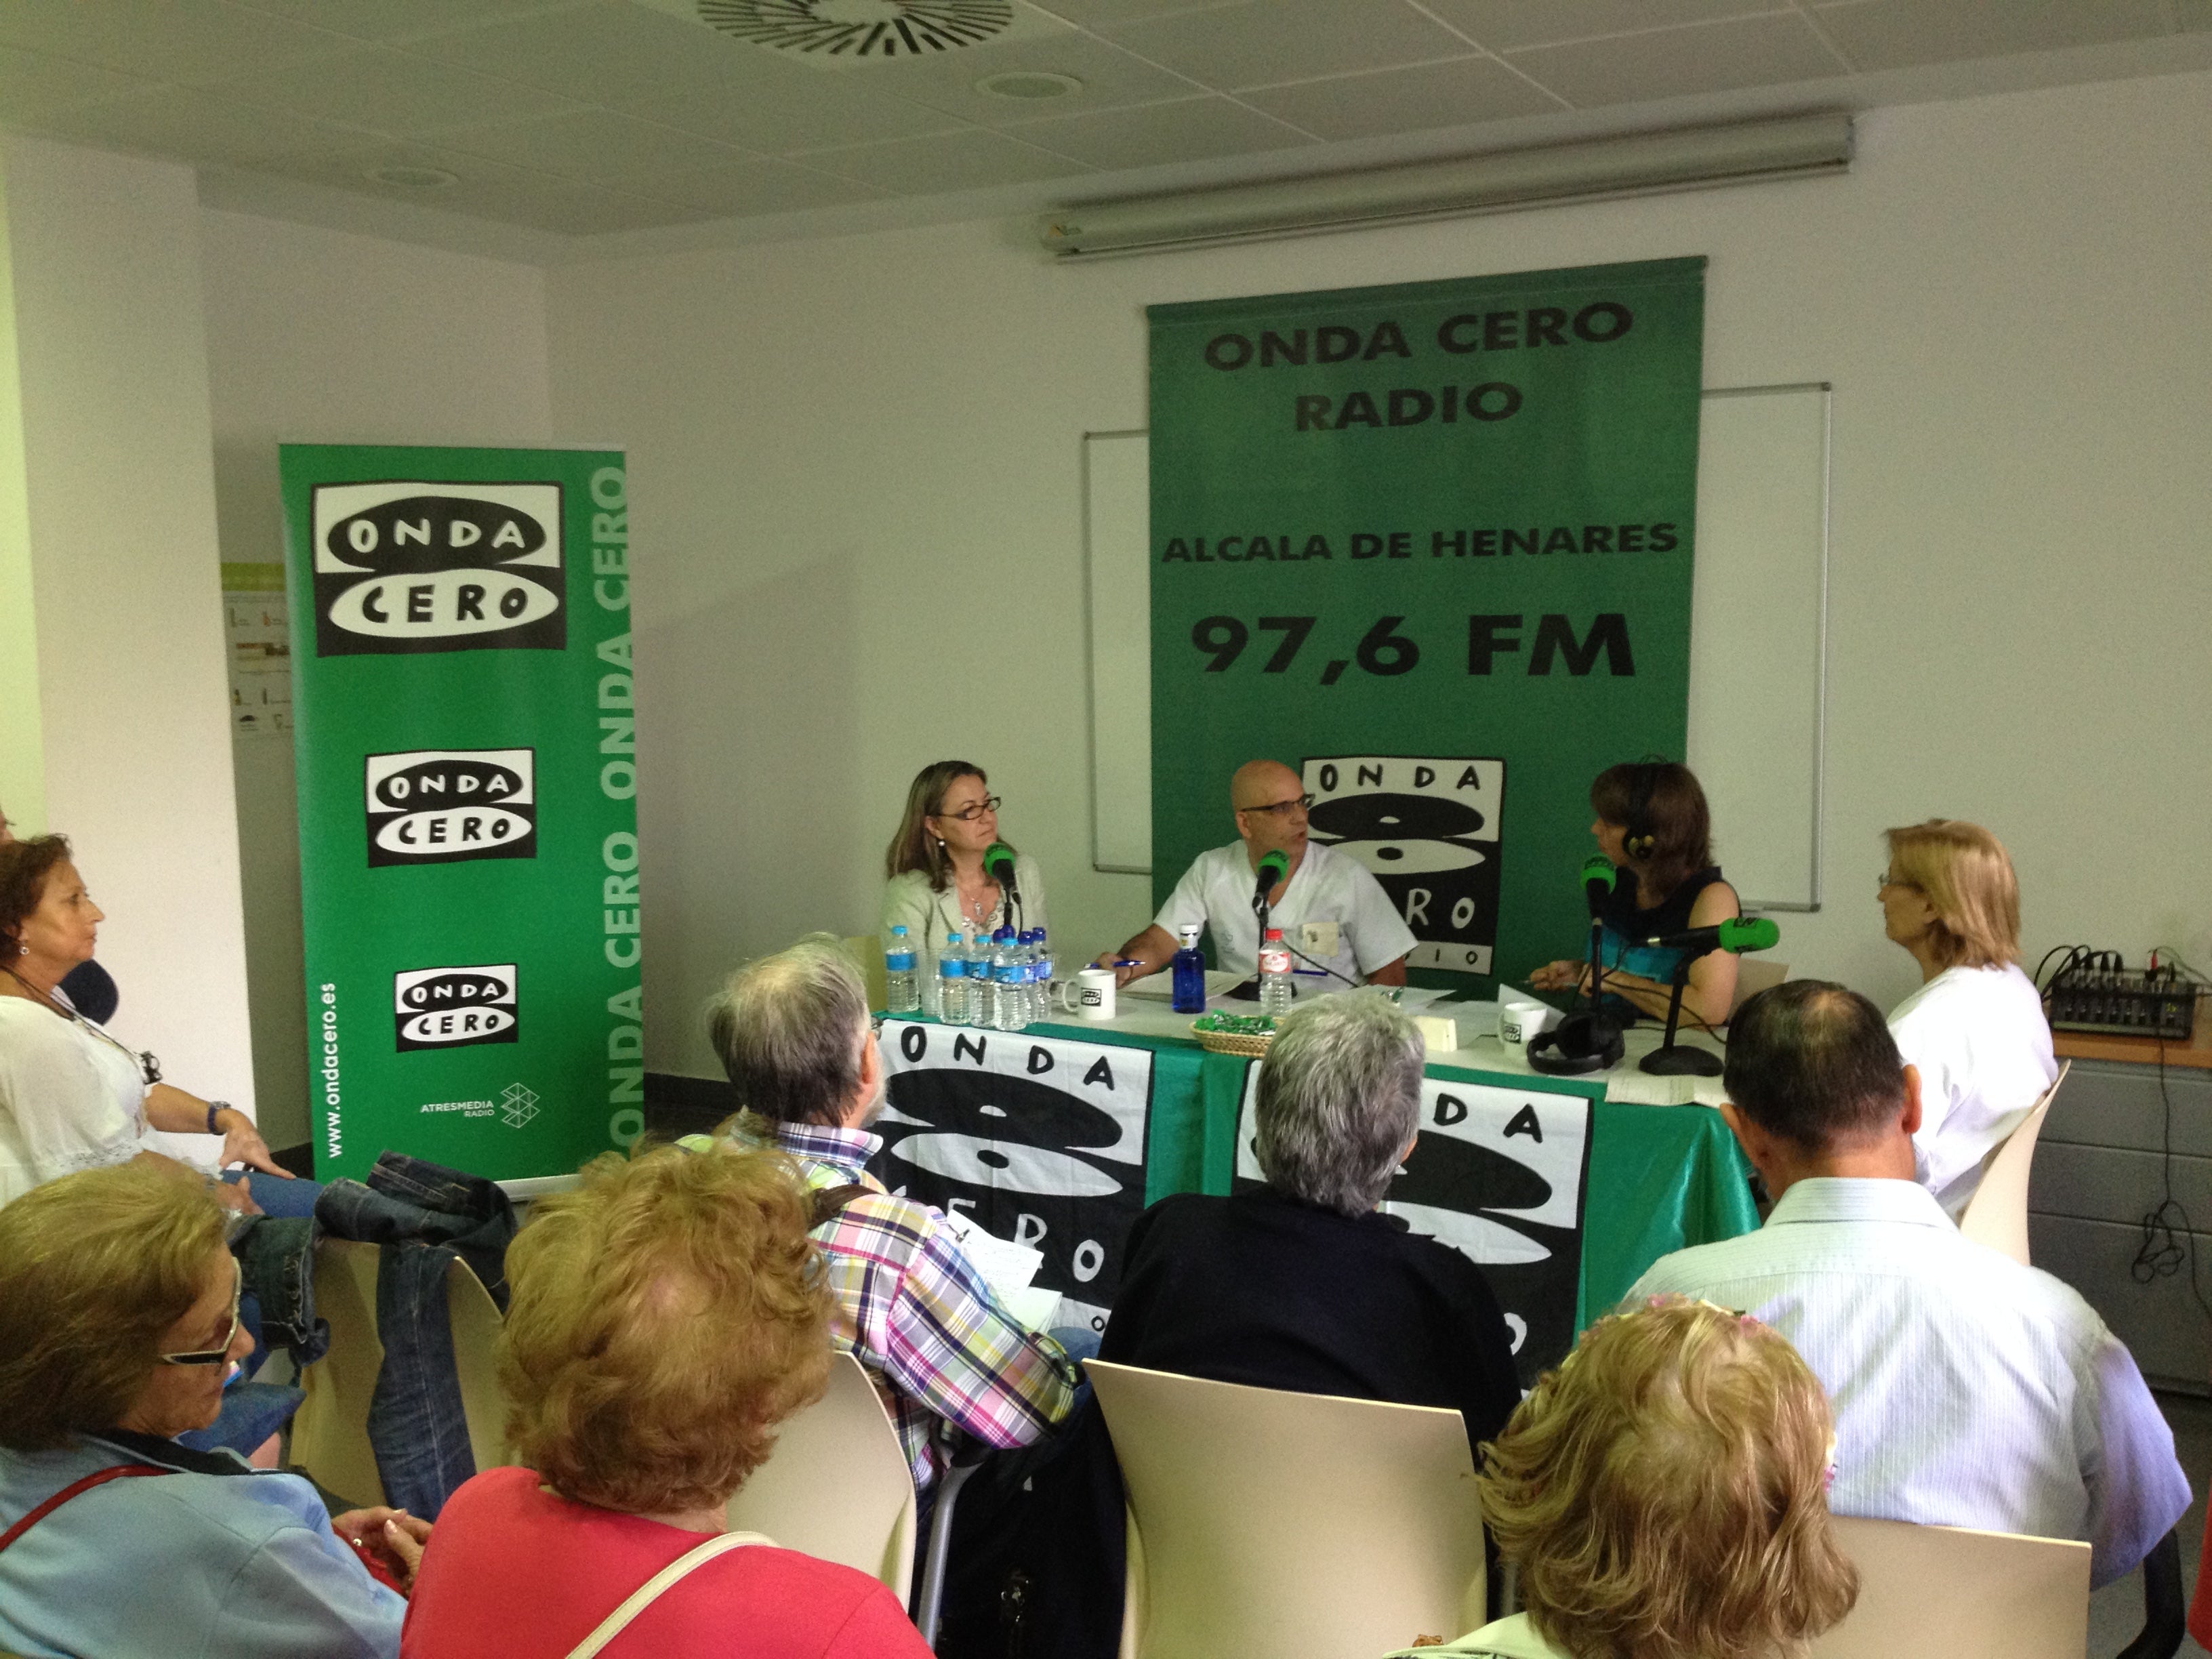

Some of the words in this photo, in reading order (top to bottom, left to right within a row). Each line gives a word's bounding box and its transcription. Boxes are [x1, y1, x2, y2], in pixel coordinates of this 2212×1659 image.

[1205, 321, 1411, 371] ONDA
[1437, 302, 1633, 354] CERO
[1295, 382, 1523, 432] RADIO
[348, 518, 525, 553] ONDA
[592, 467, 630, 611] CERO
[1162, 535, 1332, 563] ALCALA
[1351, 532, 1411, 560] DE
[1432, 523, 1677, 558] HENARES
[362, 585, 528, 623] CERO
[1191, 615, 1420, 685] 97,6
[1469, 613, 1636, 677] FM
[596, 635, 636, 800] ONDA
[388, 775, 509, 799] ONDA
[1319, 764, 1480, 792] ONDA
[398, 817, 511, 844] CERO
[602, 832, 641, 968] CERO
[1406, 887, 1475, 929] RO
[411, 983, 499, 1004] ONDA
[418, 1015, 499, 1035] CERO
[321, 983, 342, 1158] www.ondacero.es
[608, 985, 644, 1147] ONDA
[901, 1025, 1115, 1090] ONDA
[420, 1101, 494, 1113] ATRESMEDIA
[1433, 1092, 1542, 1143] DA
